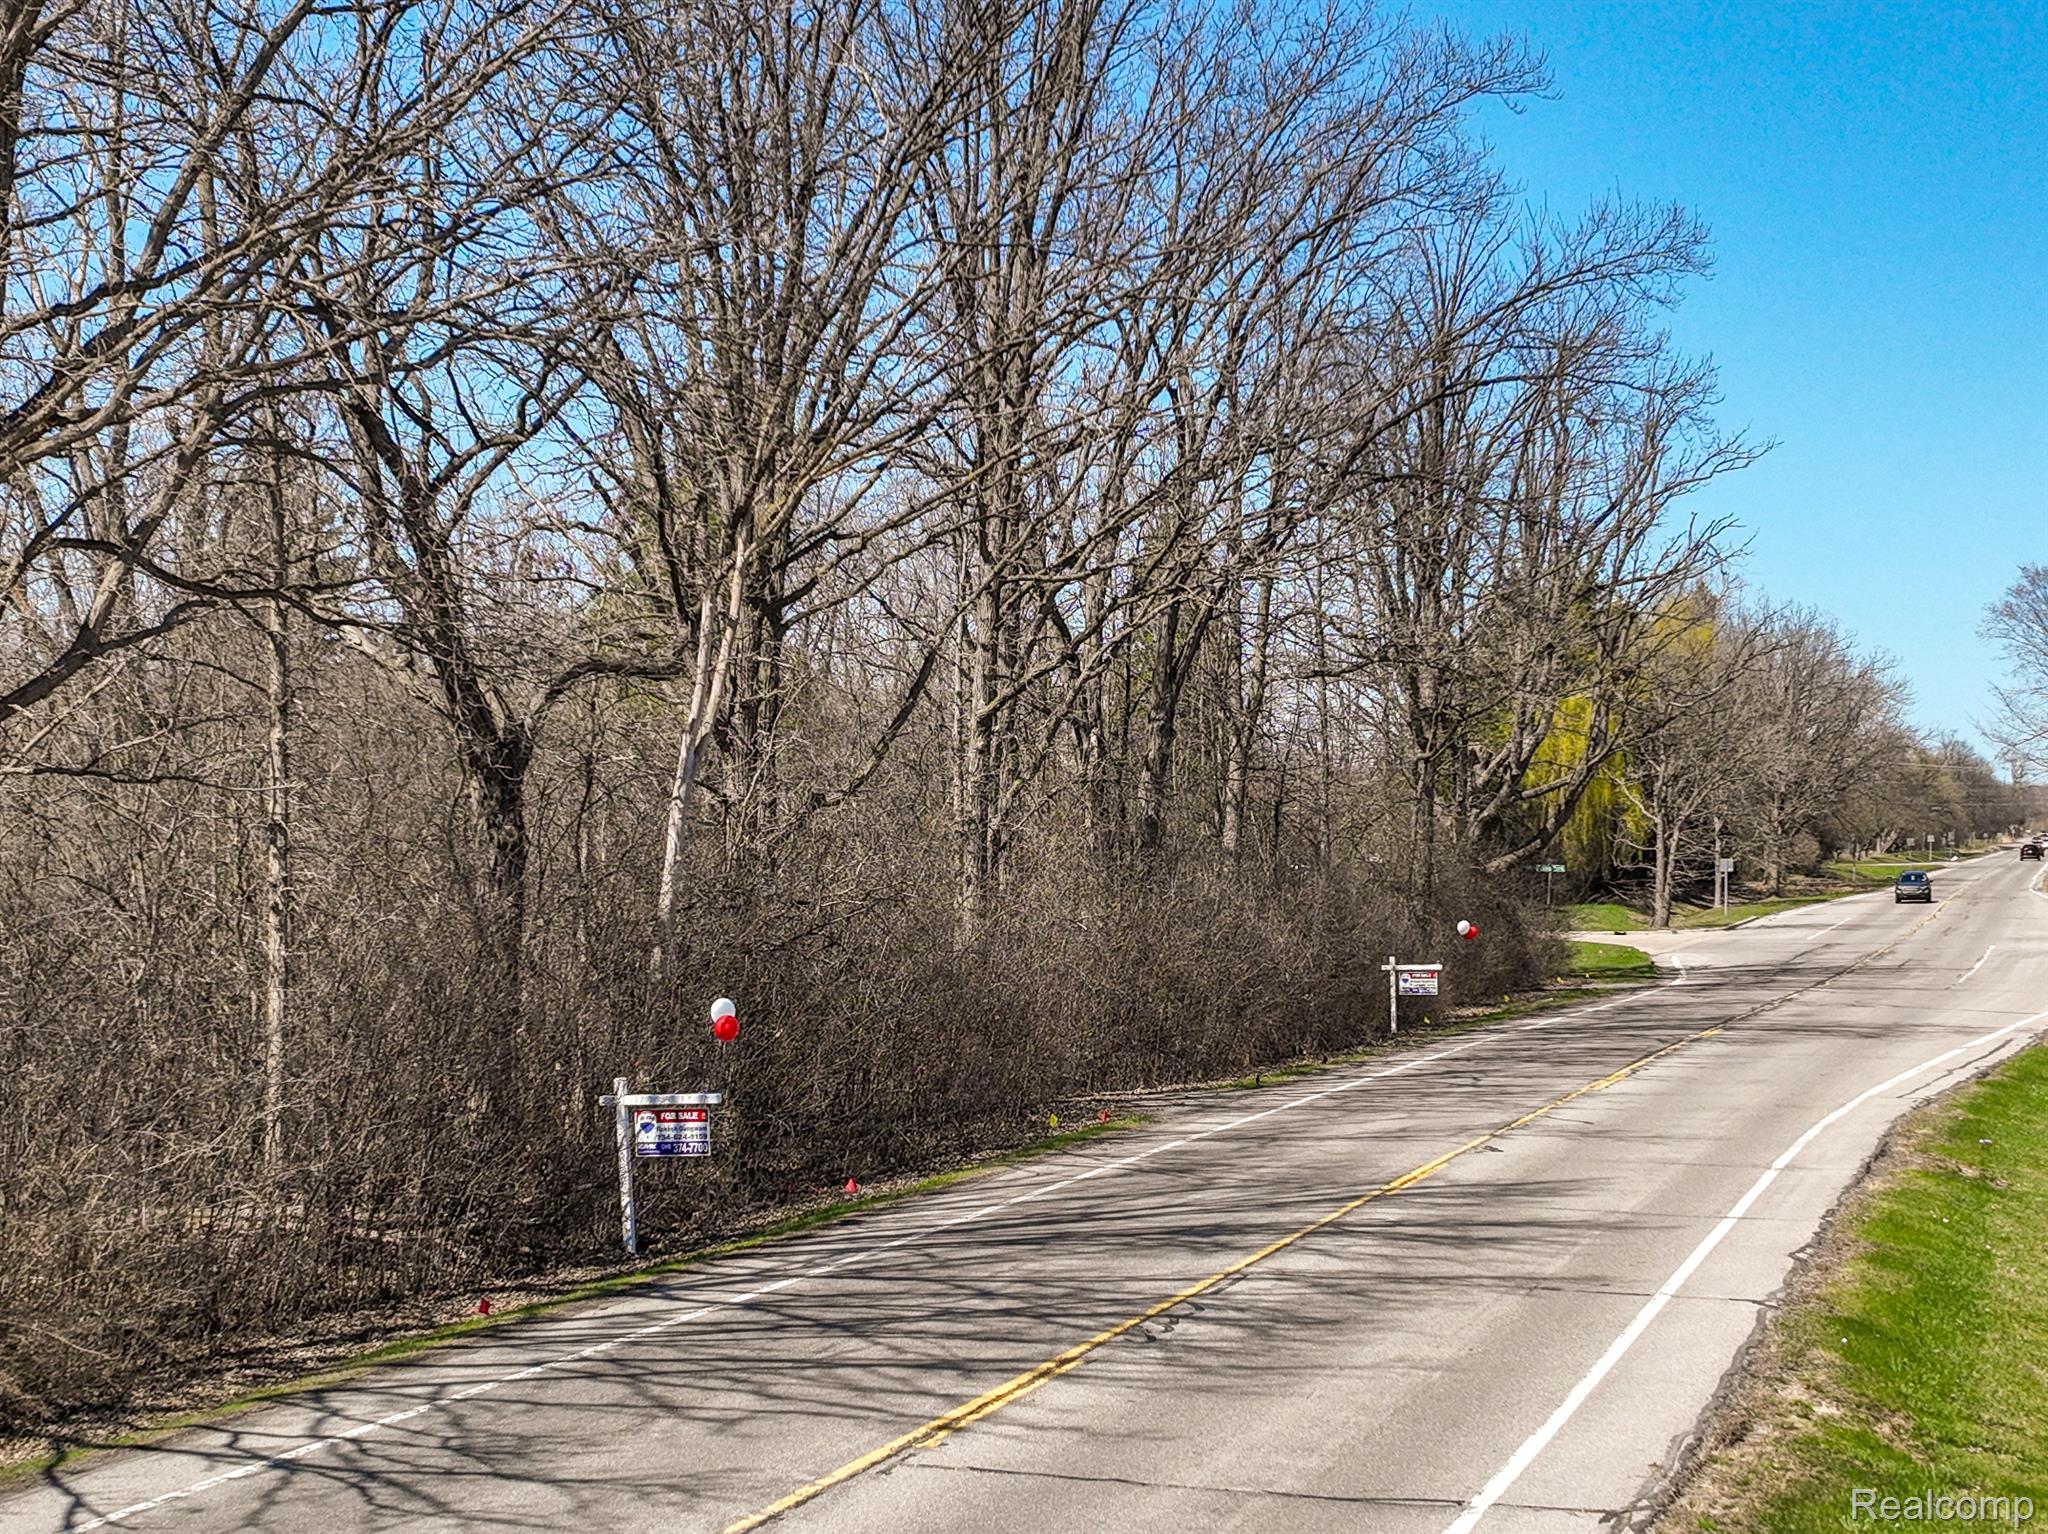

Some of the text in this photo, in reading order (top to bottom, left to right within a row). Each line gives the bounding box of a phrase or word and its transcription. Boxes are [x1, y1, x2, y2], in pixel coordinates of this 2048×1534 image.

[660, 1112, 677, 1120] FOR
[678, 1112, 699, 1120] SALE
[672, 1143, 708, 1153] 374-7700
